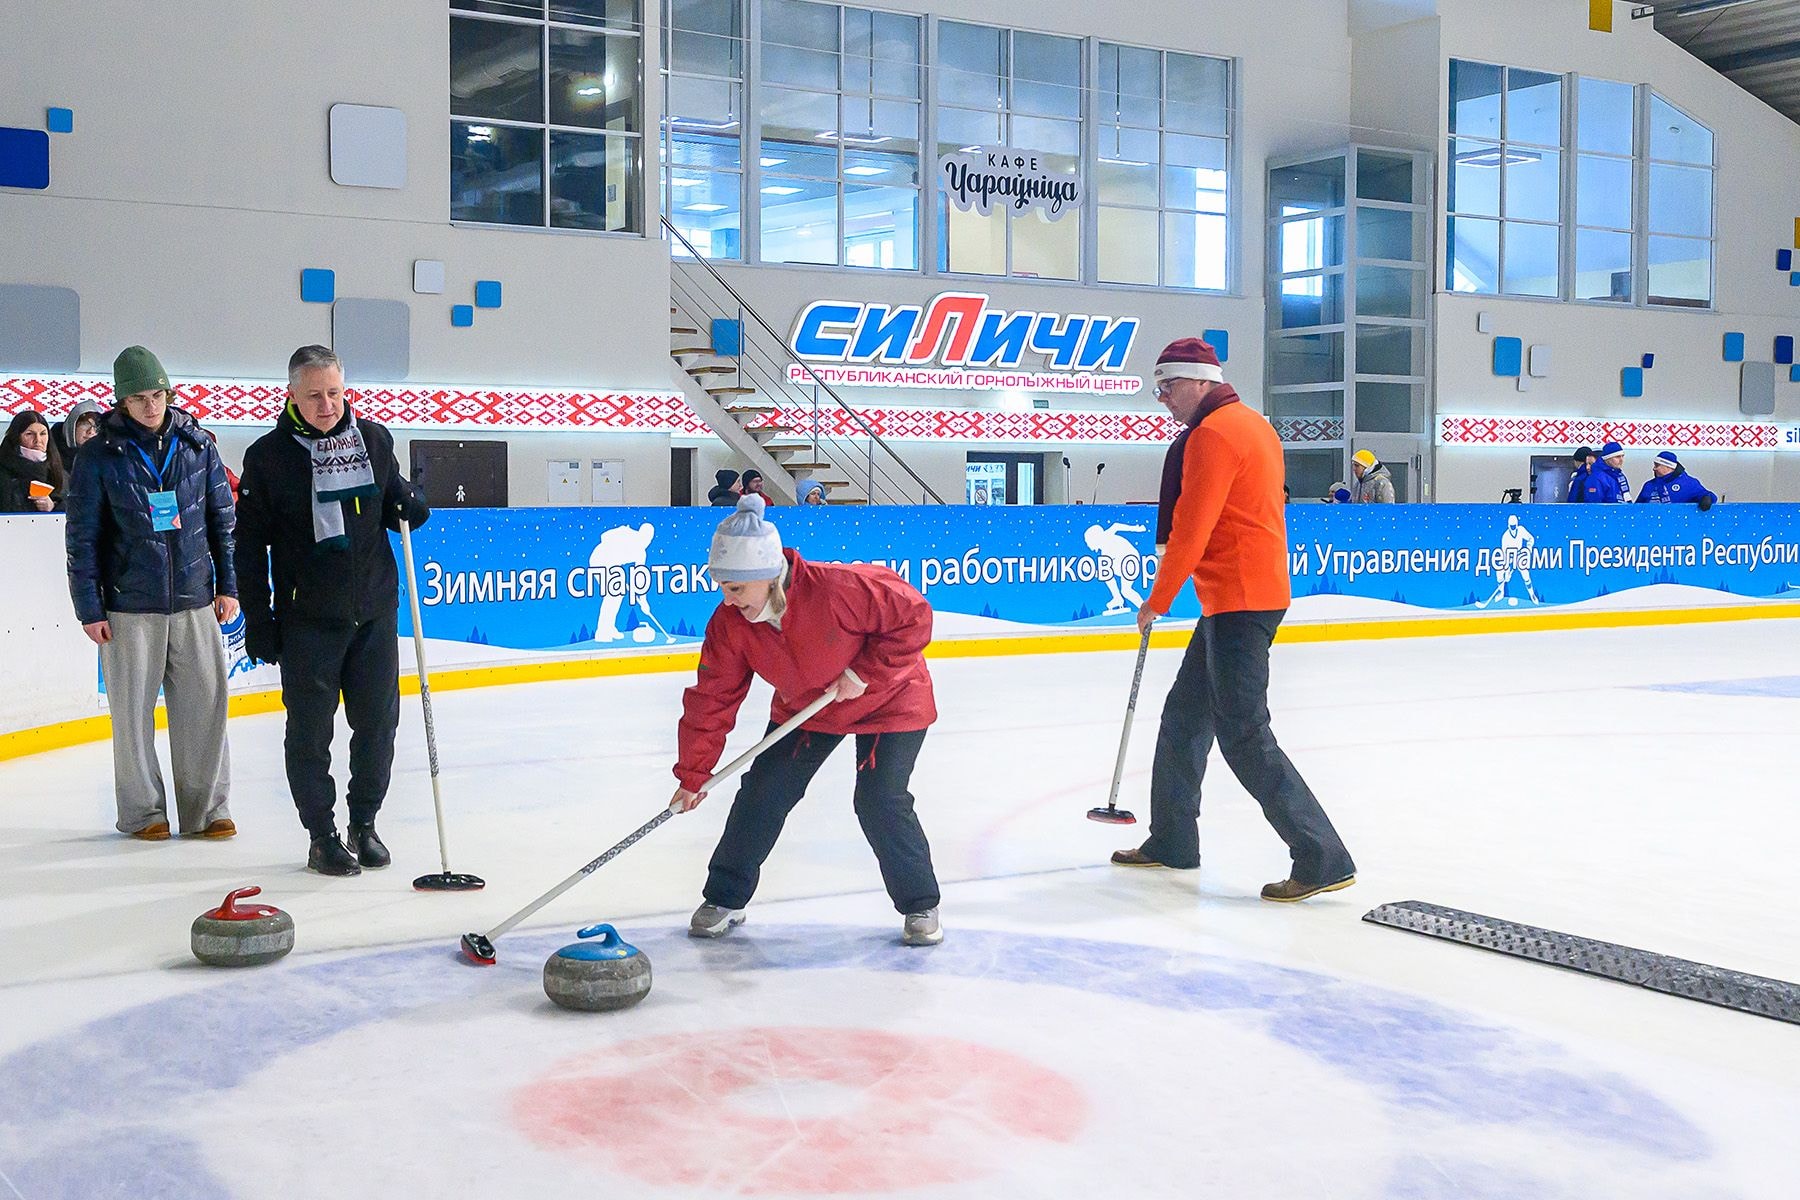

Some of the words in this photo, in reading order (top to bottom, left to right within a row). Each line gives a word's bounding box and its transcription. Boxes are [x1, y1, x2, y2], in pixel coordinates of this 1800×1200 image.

[988, 153, 1038, 171] КАФЕ
[790, 368, 963, 385] РЕСПУБЛИКАНСКИЙ
[966, 374, 1090, 390] ГОРНОЛЫЖНЫЙ
[1094, 379, 1140, 392] ЦЕНТР
[422, 561, 557, 606] Зимняя
[566, 563, 720, 606] спартак
[920, 546, 1115, 595] работников
[1314, 543, 1470, 582] Управления
[1475, 547, 1563, 577] делами
[1569, 539, 1697, 577] Президента
[1701, 535, 1799, 572] Республи
